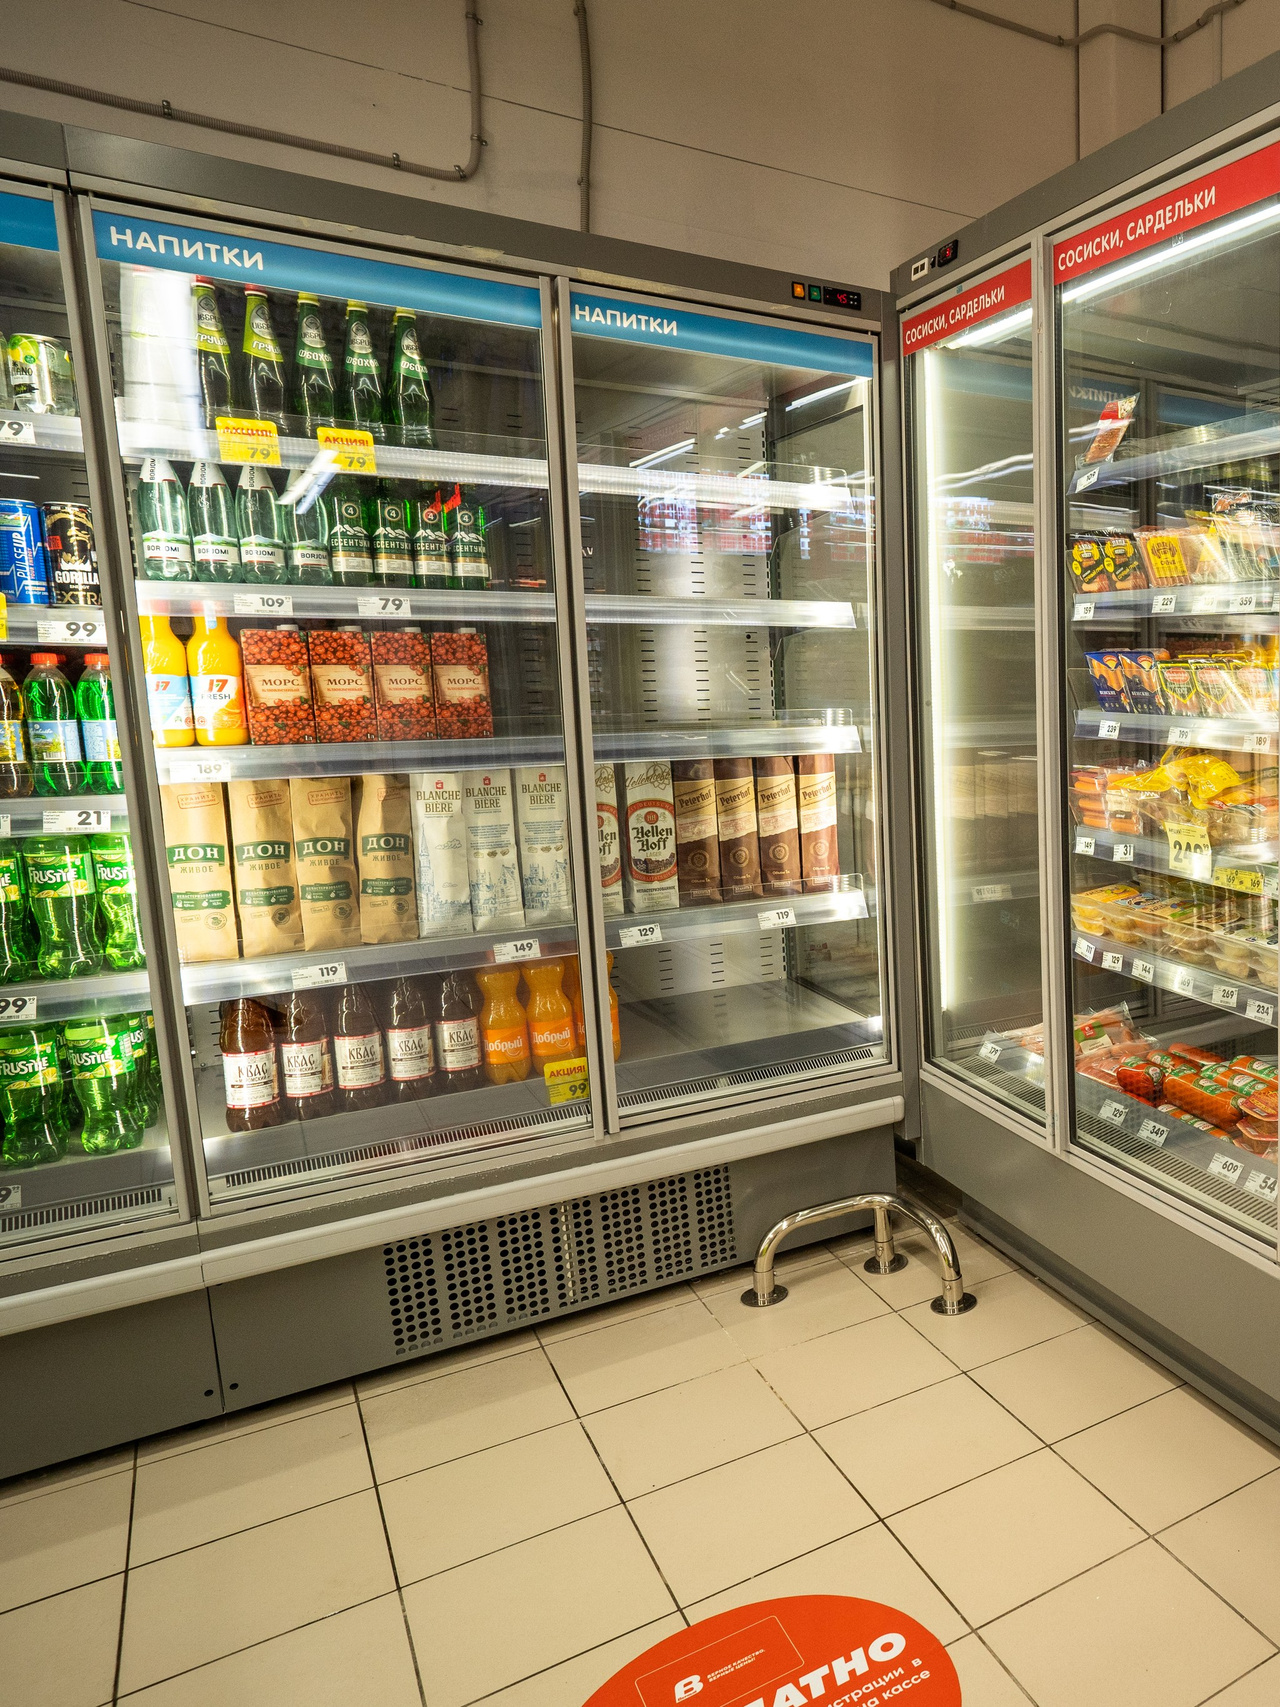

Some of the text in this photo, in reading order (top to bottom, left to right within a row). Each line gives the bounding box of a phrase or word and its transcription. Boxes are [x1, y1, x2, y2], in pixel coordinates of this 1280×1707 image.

[1057, 186, 1217, 272] СОСИСКИ, САРДЕЛЬКИ
[110, 225, 264, 272] НАПИТКИ
[574, 304, 678, 336] НАПИТКИ
[905, 285, 1005, 345] СОСИСКИ, САРДЕЛЬКИ
[223, 426, 273, 438] АКЦИЯ!
[324, 436, 369, 447] АКЦИЯ!
[247, 447, 271, 459] 79
[345, 456, 367, 468] 79
[331, 538, 370, 547] ЕССЕНТУКИ
[373, 541, 411, 549] ЕССЕНТУКИ
[55, 571, 99, 585] GORILLA
[259, 596, 284, 608] 109
[377, 597, 404, 611] 79
[1239, 597, 1252, 605] 359
[66, 622, 97, 637] 99
[262, 678, 299, 686] МОРС
[327, 678, 363, 686] МОРС
[197, 762, 222, 774] 189
[416, 788, 461, 802] BLANCHE
[465, 786, 508, 798] BLANCHE
[522, 782, 562, 795] BLANCHE
[760, 784, 792, 803] Peterhof
[802, 783, 832, 800] Peterhof
[474, 796, 501, 810] BIÈRE
[529, 793, 556, 806] BIÈRE
[678, 789, 713, 808] Peterhof
[719, 787, 751, 807] Peterhof
[424, 800, 454, 814] BIÈRE
[77, 810, 102, 826] 21
[631, 826, 673, 840] Hellen
[303, 840, 345, 854] ДОН
[367, 836, 405, 849] ДОН
[636, 837, 668, 852] Hoff
[173, 846, 219, 861] ДОН
[242, 844, 285, 858] ДОН
[1123, 846, 1132, 856] 31
[180, 865, 214, 874] ЖИВОЕ
[249, 862, 281, 871] ЖИВОЕ
[309, 859, 340, 867] ЖИВОЕ
[28, 865, 78, 885] FRUSTYLE
[776, 911, 789, 921] 119
[638, 927, 655, 938] 129
[513, 942, 533, 954] 149
[318, 964, 339, 978] 119
[1222, 989, 1234, 999] 269
[1256, 1006, 1270, 1016] 234
[450, 1028, 474, 1043] КВАС
[532, 1027, 570, 1043] Добрый
[397, 1036, 424, 1051] КВАС
[484, 1036, 523, 1052] Добрый
[348, 1045, 375, 1060] КВАС
[287, 1054, 316, 1068] КВАС
[238, 1063, 268, 1078] КВАС
[549, 1064, 586, 1078] АКЦИЯ!
[569, 1082, 587, 1096] 99
[1112, 1108, 1124, 1118] 129
[1150, 1126, 1165, 1138] 349
[1222, 1161, 1239, 1174] 609
[1259, 1177, 1277, 1192] 54
[707, 1648, 766, 1679] ВЕРНОЕ КАЧЕСТВО,
[708, 1657, 756, 1682] ВЕРНЫЕ ЦЕНЫ!
[743, 1632, 906, 1707] АТНО
[674, 1674, 704, 1704] В
[883, 1669, 930, 1700] кассе
